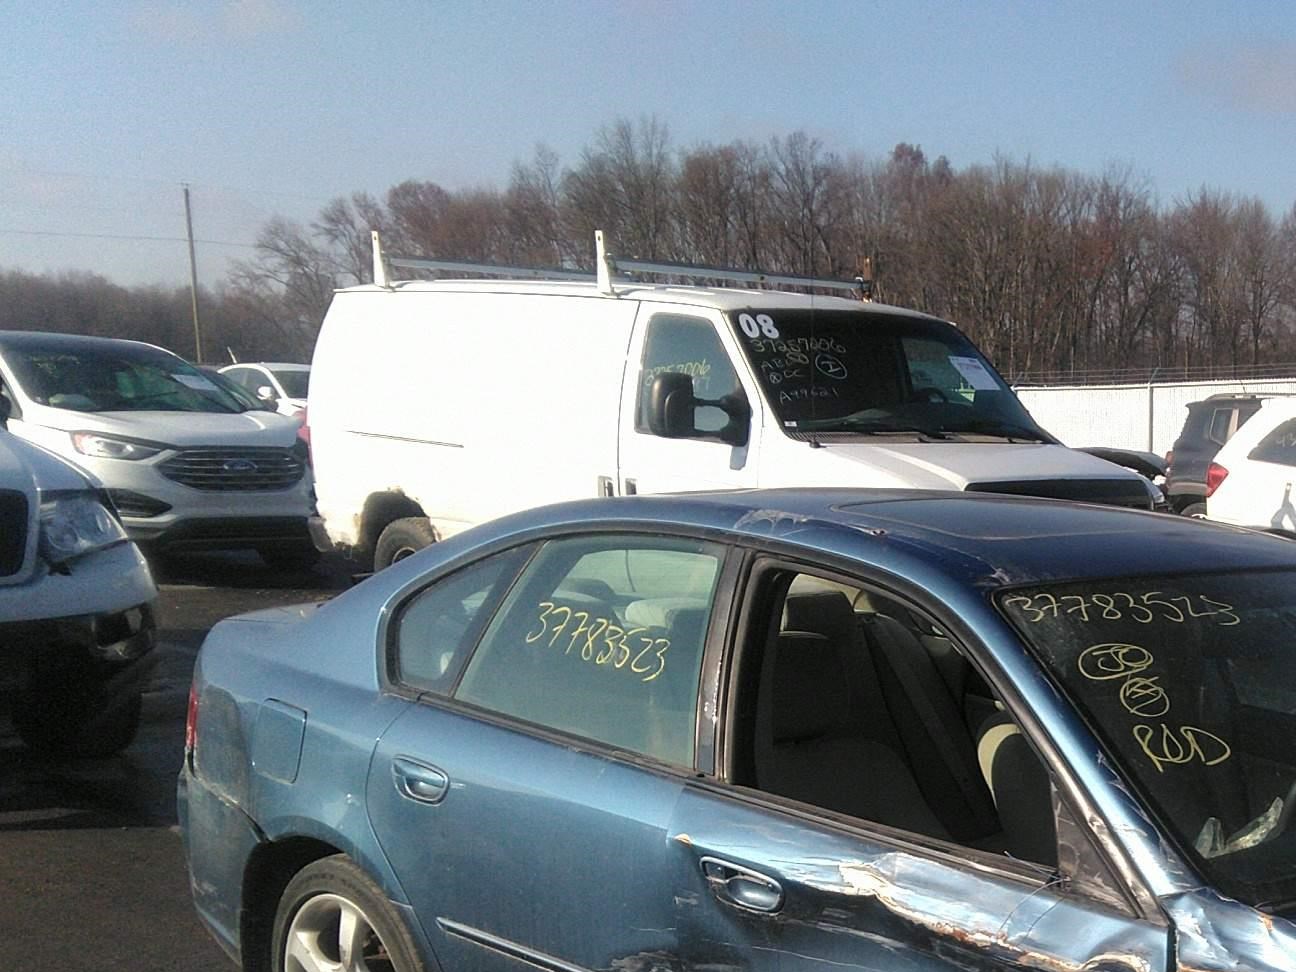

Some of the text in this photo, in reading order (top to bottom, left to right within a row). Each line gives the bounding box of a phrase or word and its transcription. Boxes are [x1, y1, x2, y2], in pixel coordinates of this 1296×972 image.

[738, 313, 779, 339] 08
[1004, 591, 1241, 626] 37783523
[526, 602, 671, 682] 37783523
